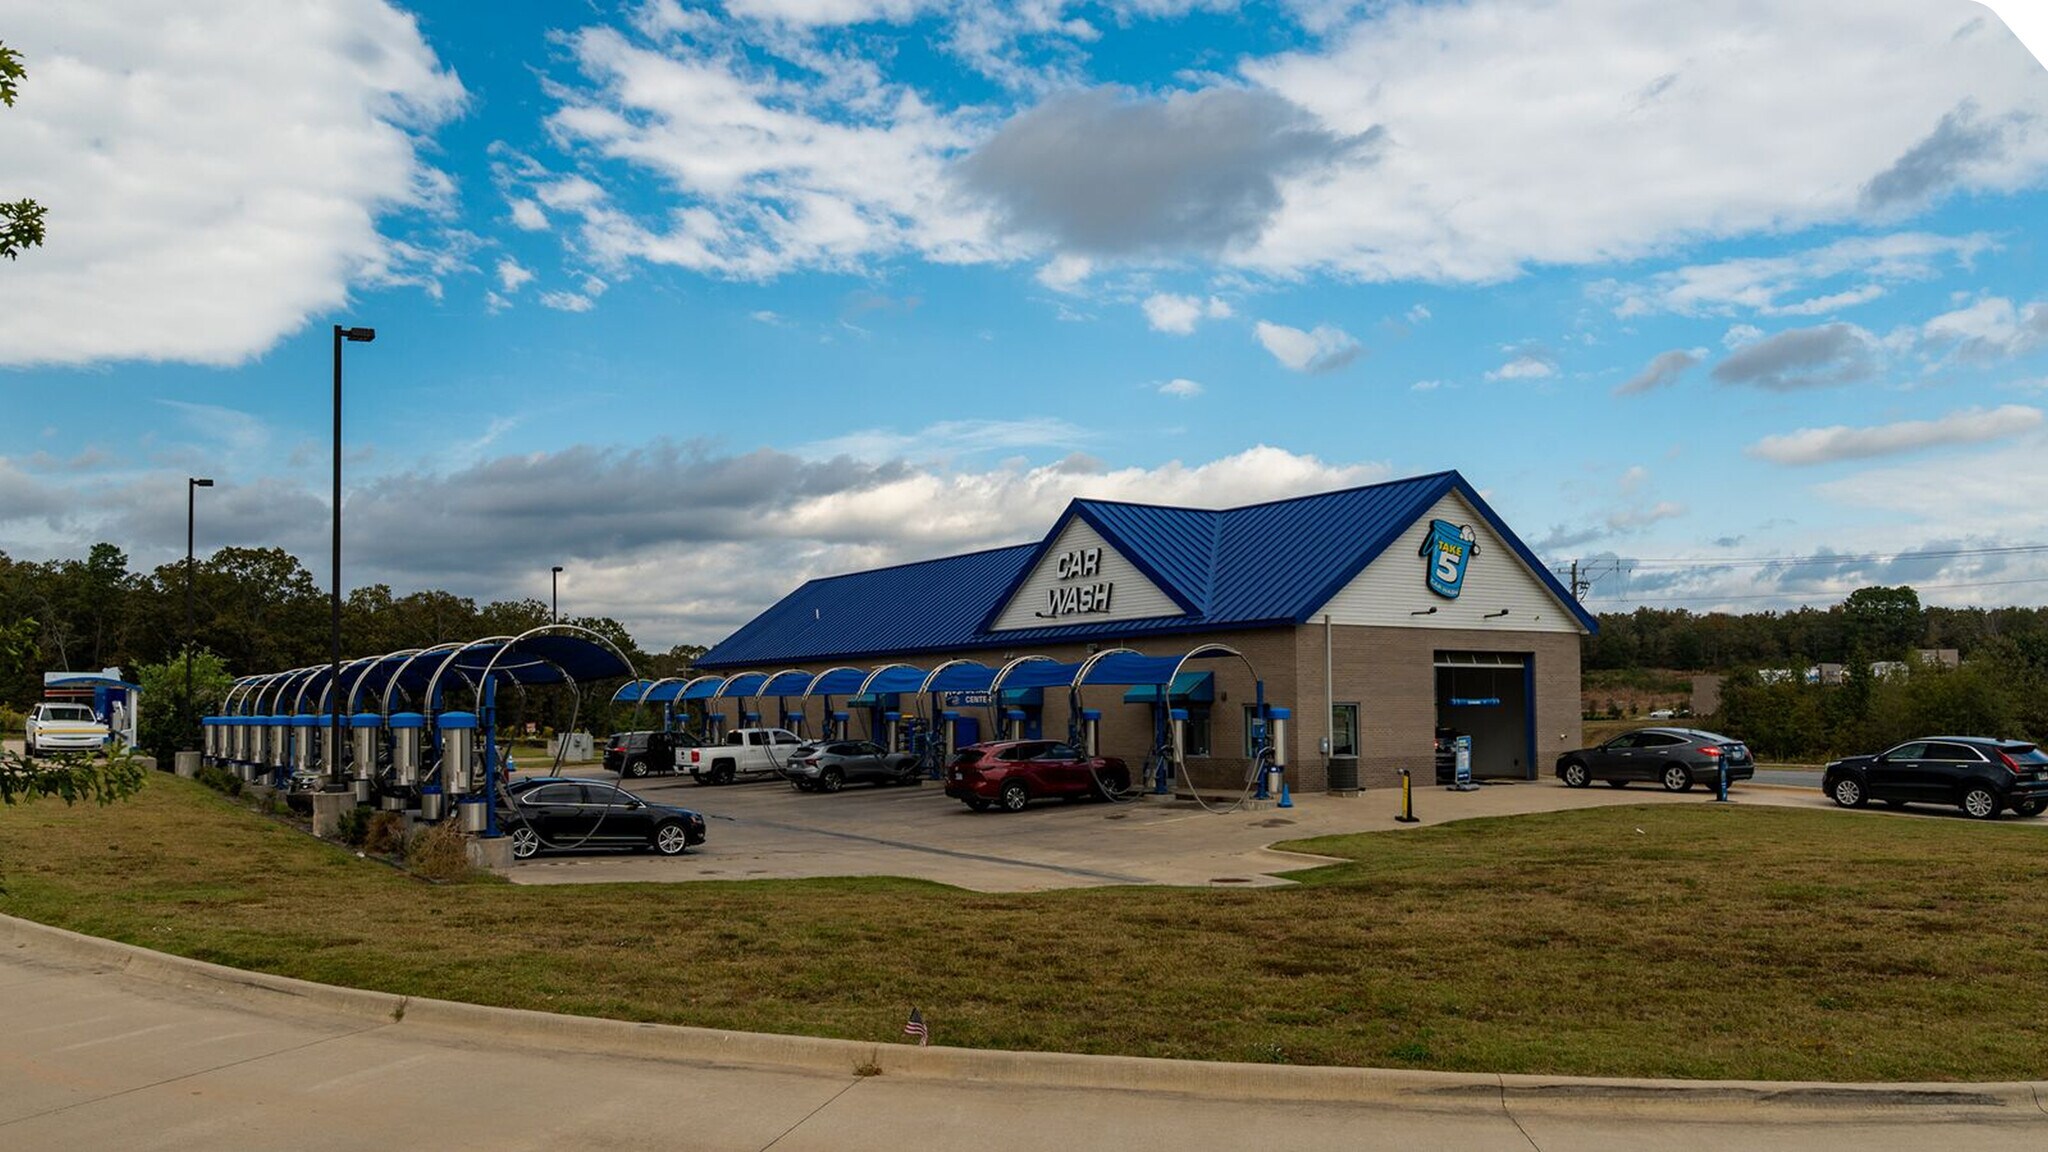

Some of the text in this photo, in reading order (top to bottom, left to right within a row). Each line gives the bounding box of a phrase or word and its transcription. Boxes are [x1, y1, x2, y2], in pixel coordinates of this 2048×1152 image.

[1056, 548, 1100, 579] CAR
[1438, 541, 1463, 556] TAKE
[1436, 552, 1460, 583] 5
[1047, 583, 1111, 614] WASH
